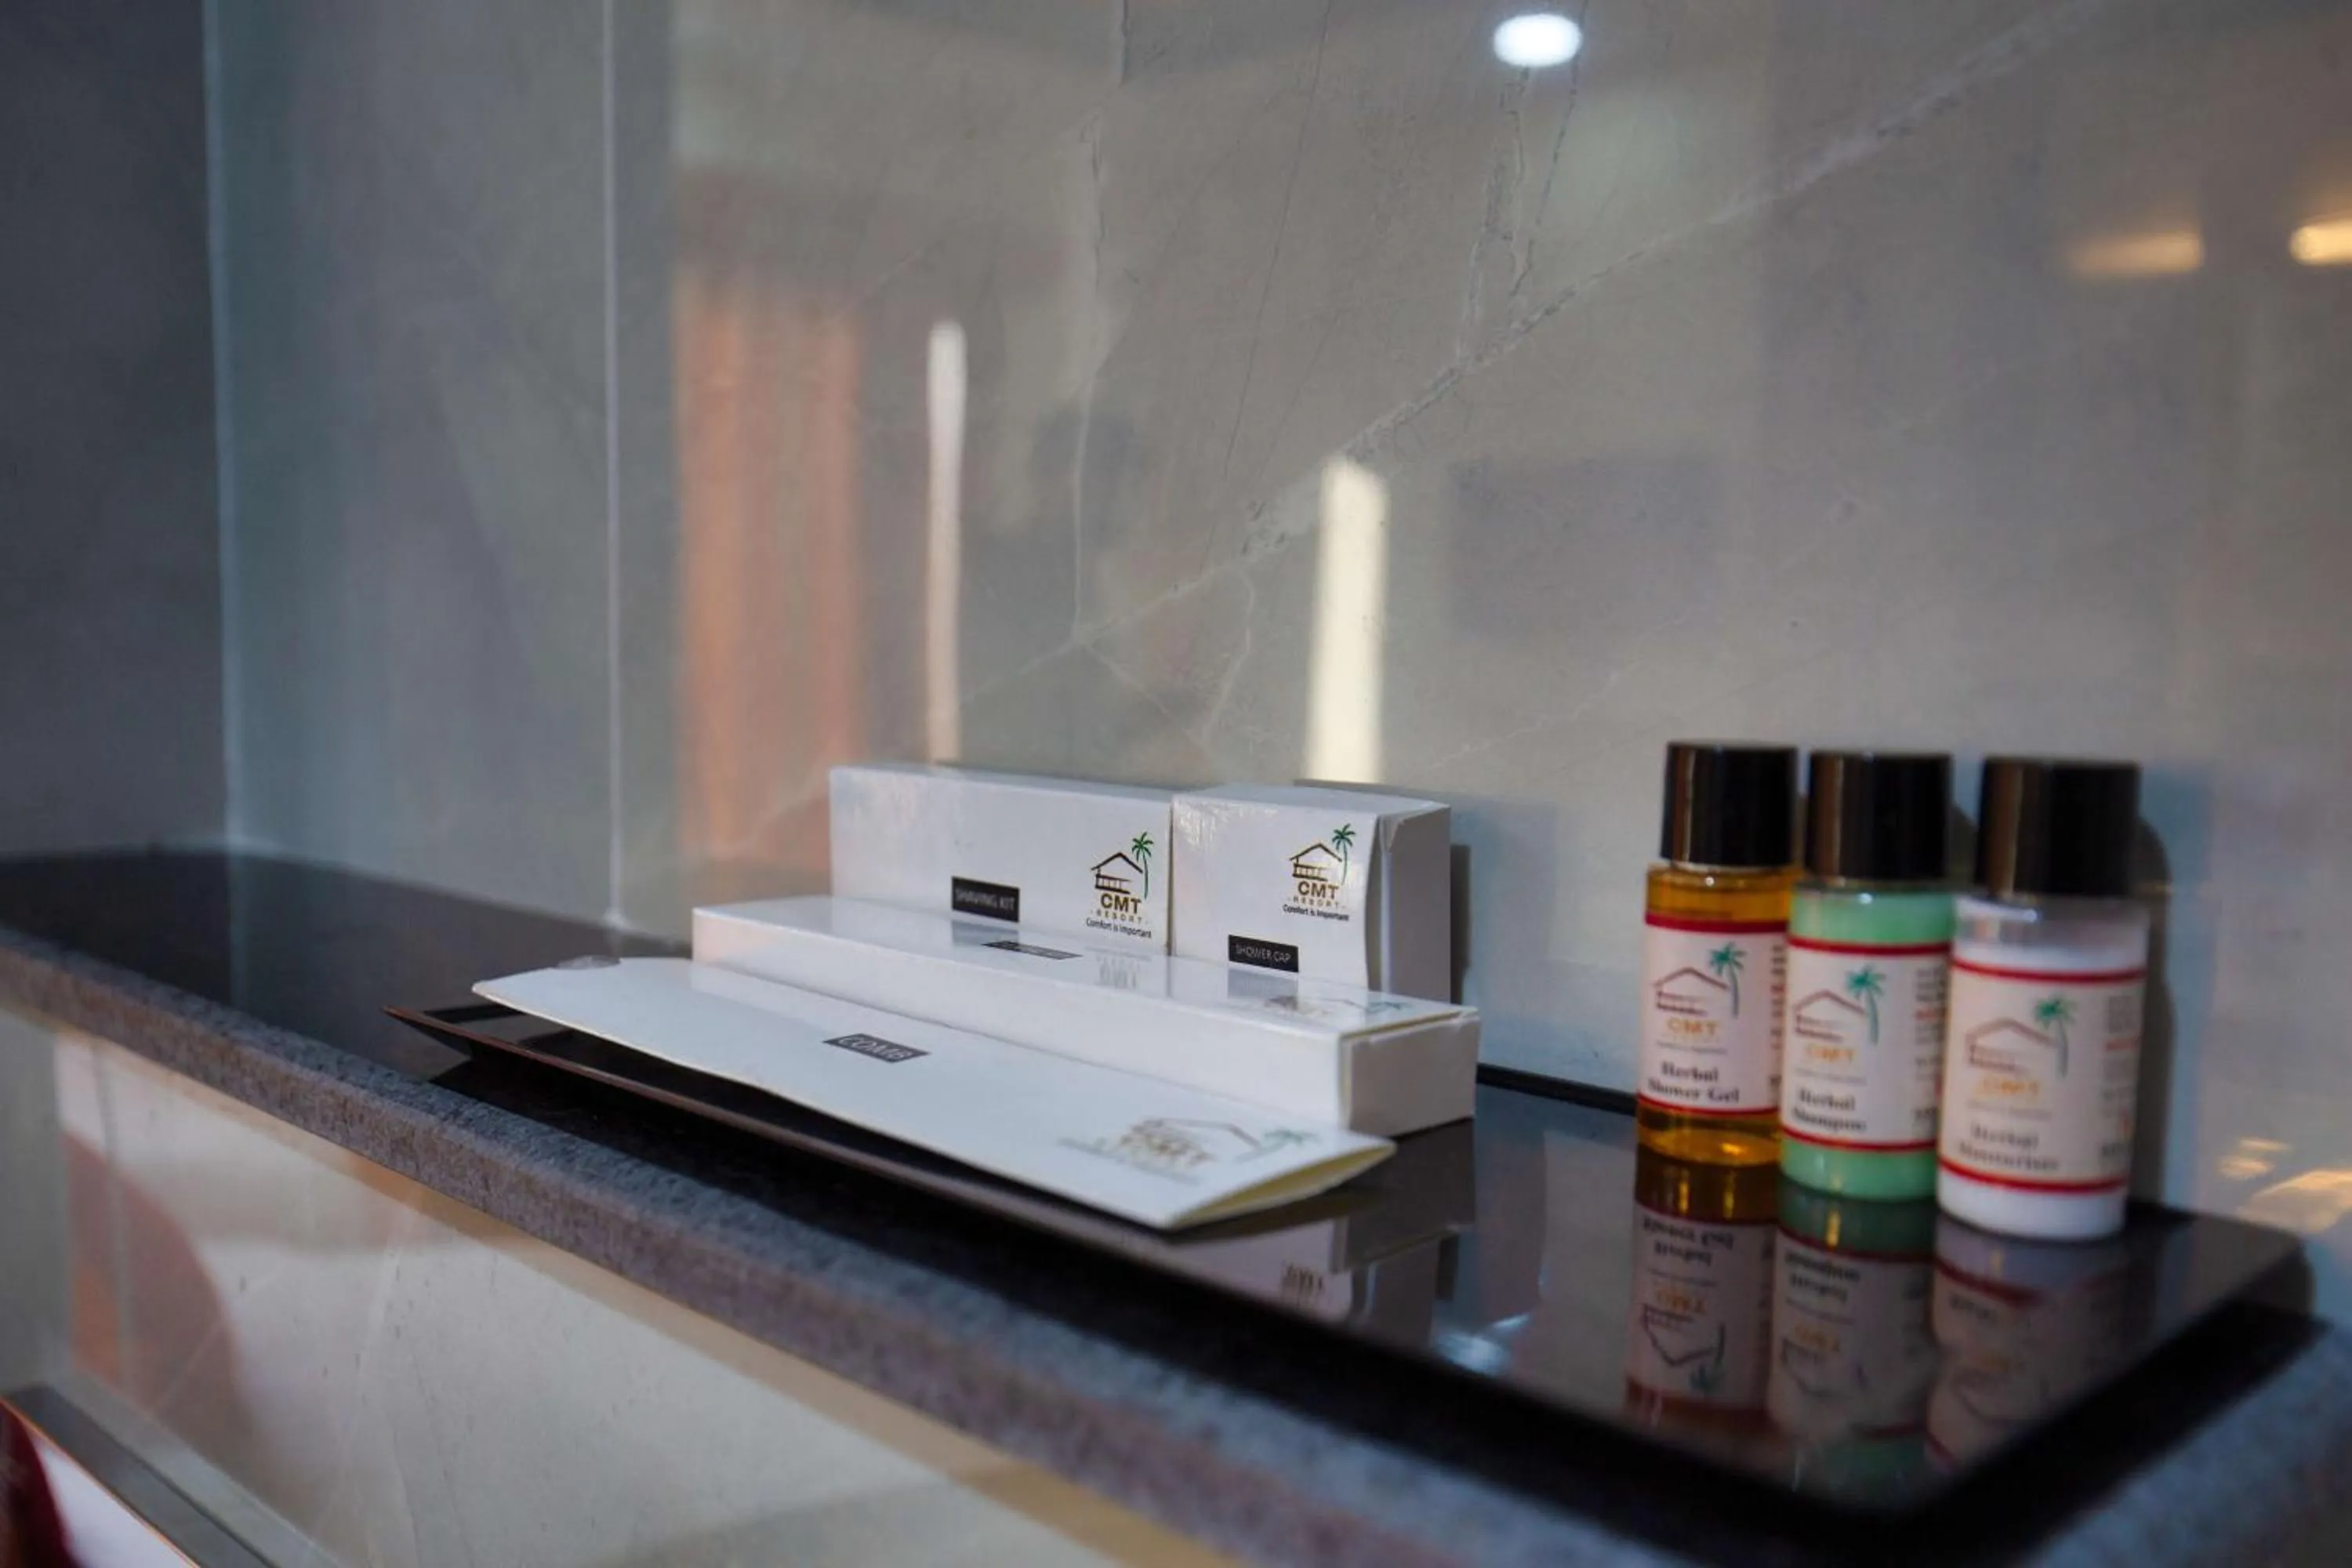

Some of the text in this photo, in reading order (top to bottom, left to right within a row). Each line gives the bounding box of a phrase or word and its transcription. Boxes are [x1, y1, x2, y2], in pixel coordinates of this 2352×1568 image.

[1298, 880, 1340, 900] CMT
[1100, 893, 1142, 915] CMT
[1282, 903, 1308, 916] Comfort
[1086, 916, 1112, 931] Comfort
[1234, 943, 1292, 964] SHOWER CAP
